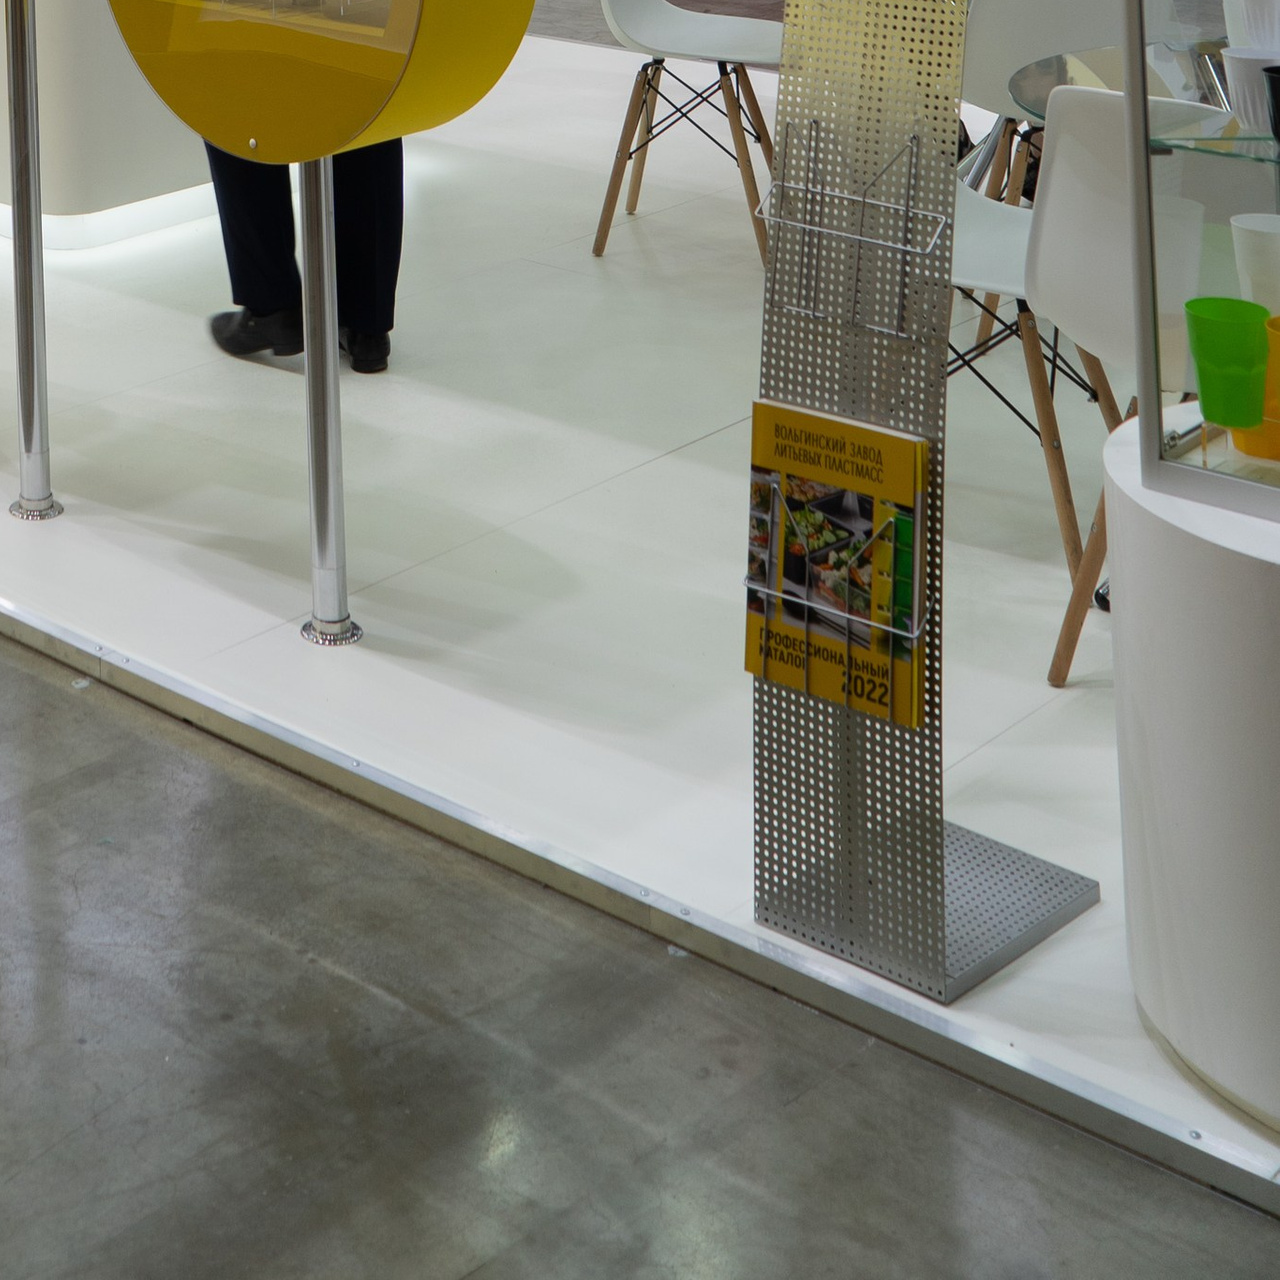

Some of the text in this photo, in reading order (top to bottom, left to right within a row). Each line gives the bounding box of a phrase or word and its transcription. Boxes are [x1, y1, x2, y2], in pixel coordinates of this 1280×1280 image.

[774, 423, 883, 467] ВОЛЬГИНСКИЙ ЗАВОД
[774, 442, 884, 484] ЛИТЬЕВЫХ ПЛАСТМАСС
[841, 670, 889, 707] 2022
